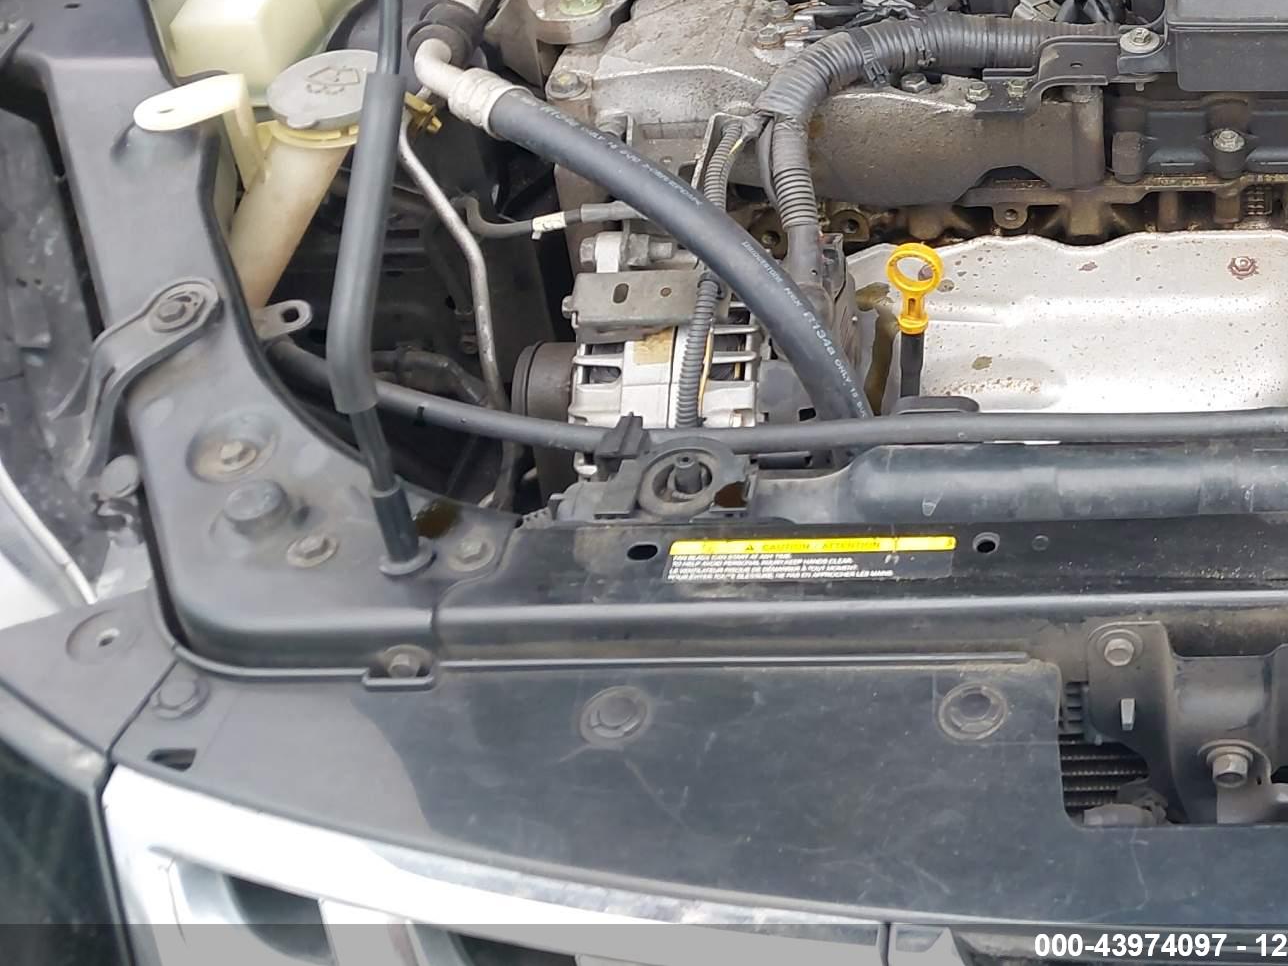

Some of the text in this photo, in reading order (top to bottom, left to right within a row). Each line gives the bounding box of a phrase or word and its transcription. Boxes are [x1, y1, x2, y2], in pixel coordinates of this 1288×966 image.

[803, 311, 836, 356] R134a
[834, 358, 852, 384] ONLY
[762, 543, 810, 551] CAUTION
[822, 541, 880, 549] ATTENTION
